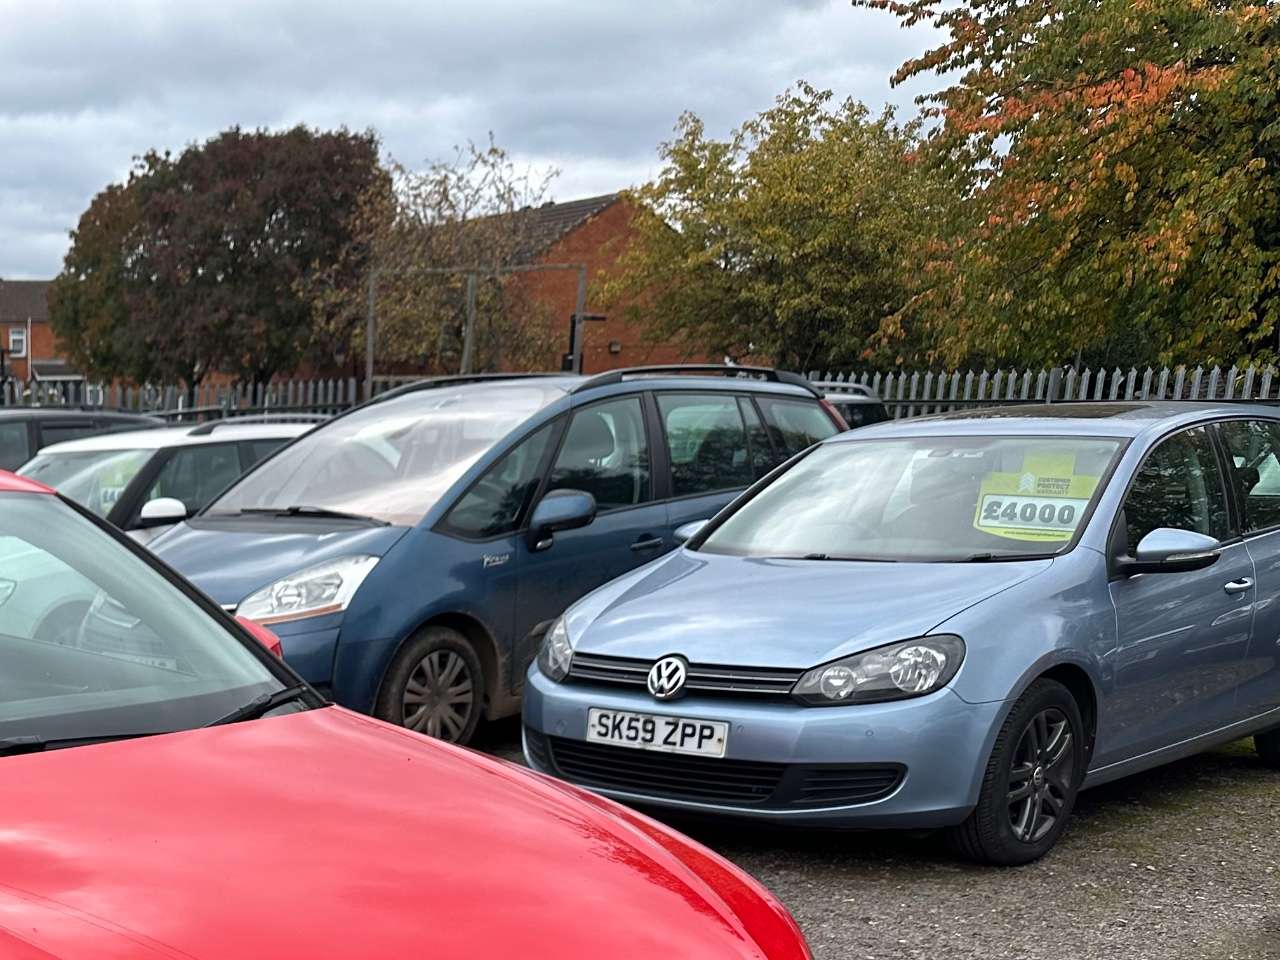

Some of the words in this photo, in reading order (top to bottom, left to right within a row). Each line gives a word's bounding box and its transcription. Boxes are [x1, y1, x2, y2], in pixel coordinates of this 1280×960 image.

[983, 501, 1075, 524] £4000
[596, 713, 656, 744] SK59
[662, 721, 715, 749] ZPP
